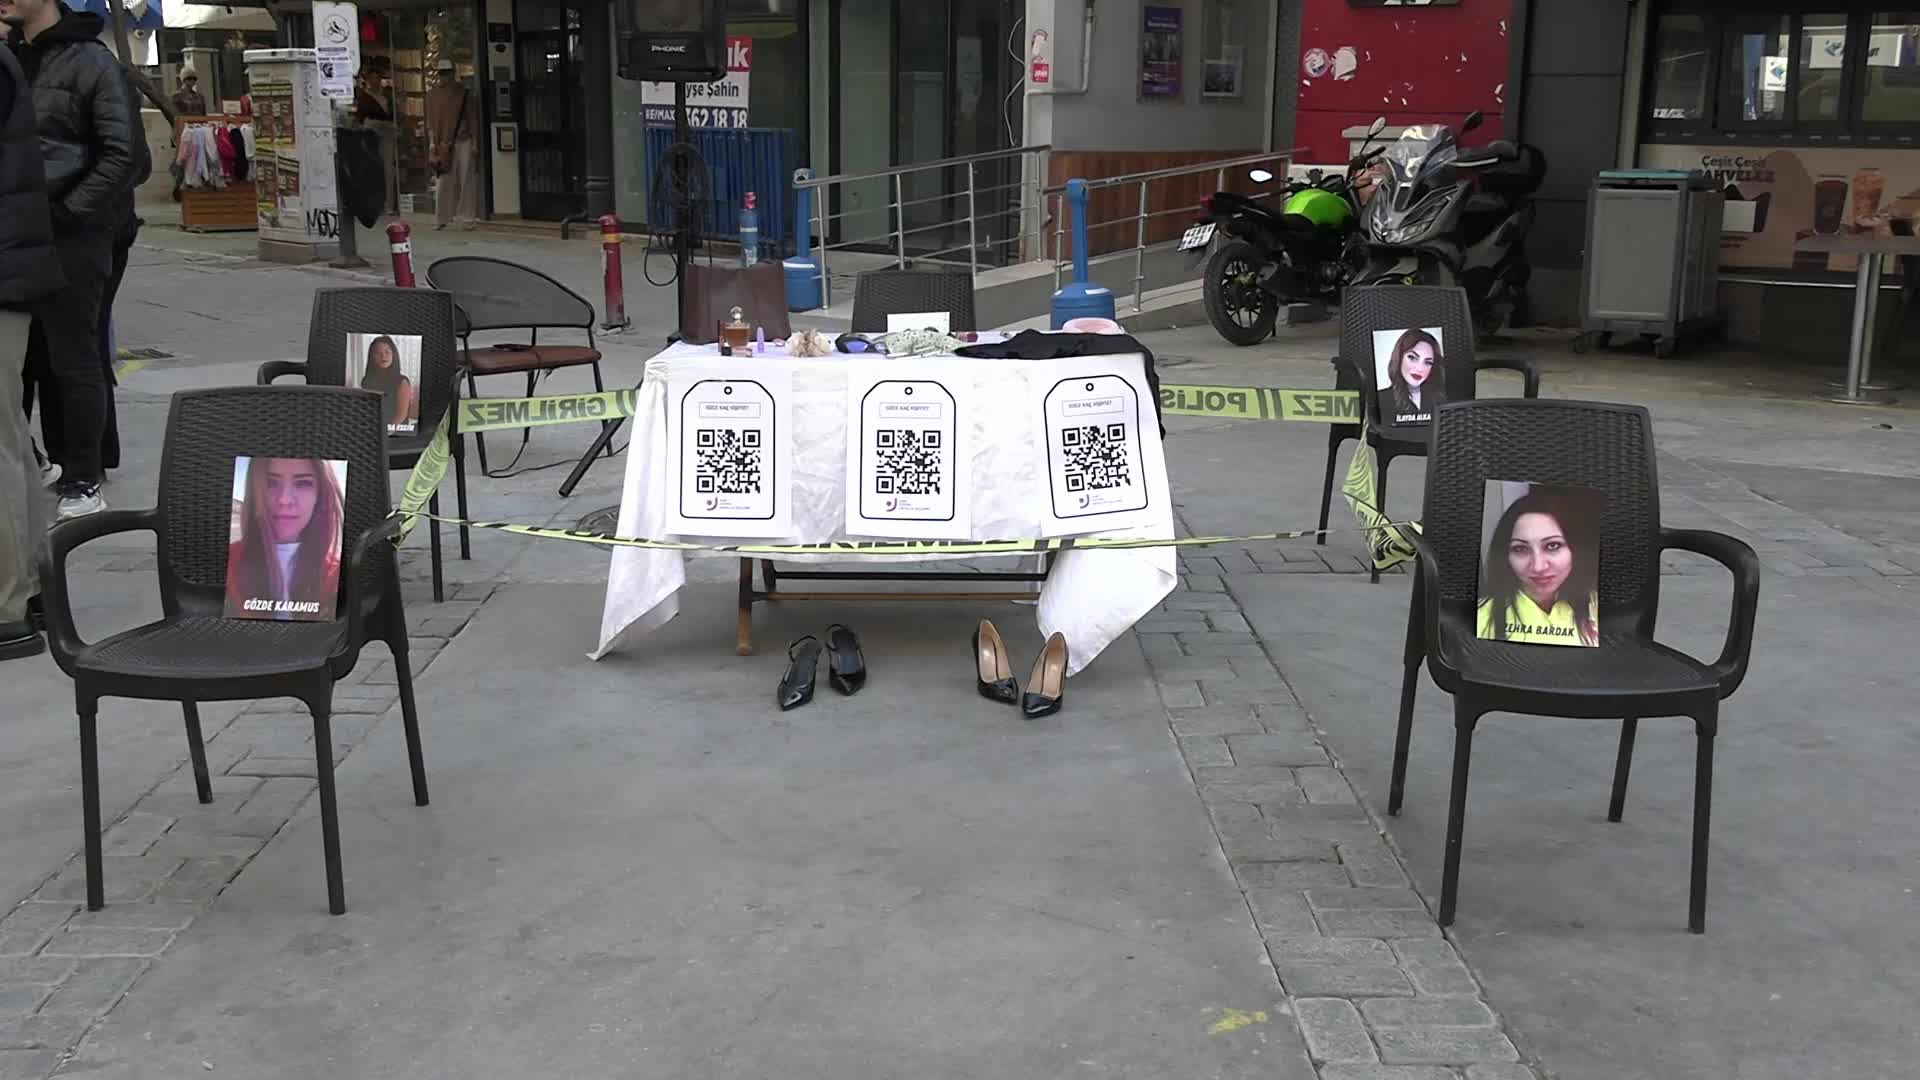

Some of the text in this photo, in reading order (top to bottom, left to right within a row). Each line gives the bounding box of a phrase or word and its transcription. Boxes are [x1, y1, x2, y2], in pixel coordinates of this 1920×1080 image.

[651, 45, 686, 53] PHONIC
[707, 82, 739, 98] Şahin
[645, 108, 676, 121] RE/MAX
[712, 108, 728, 128] 18
[732, 109, 748, 128] 18
[243, 597, 320, 612] GÖZDE KARAMUS
[1536, 625, 1575, 637] BARDAK
